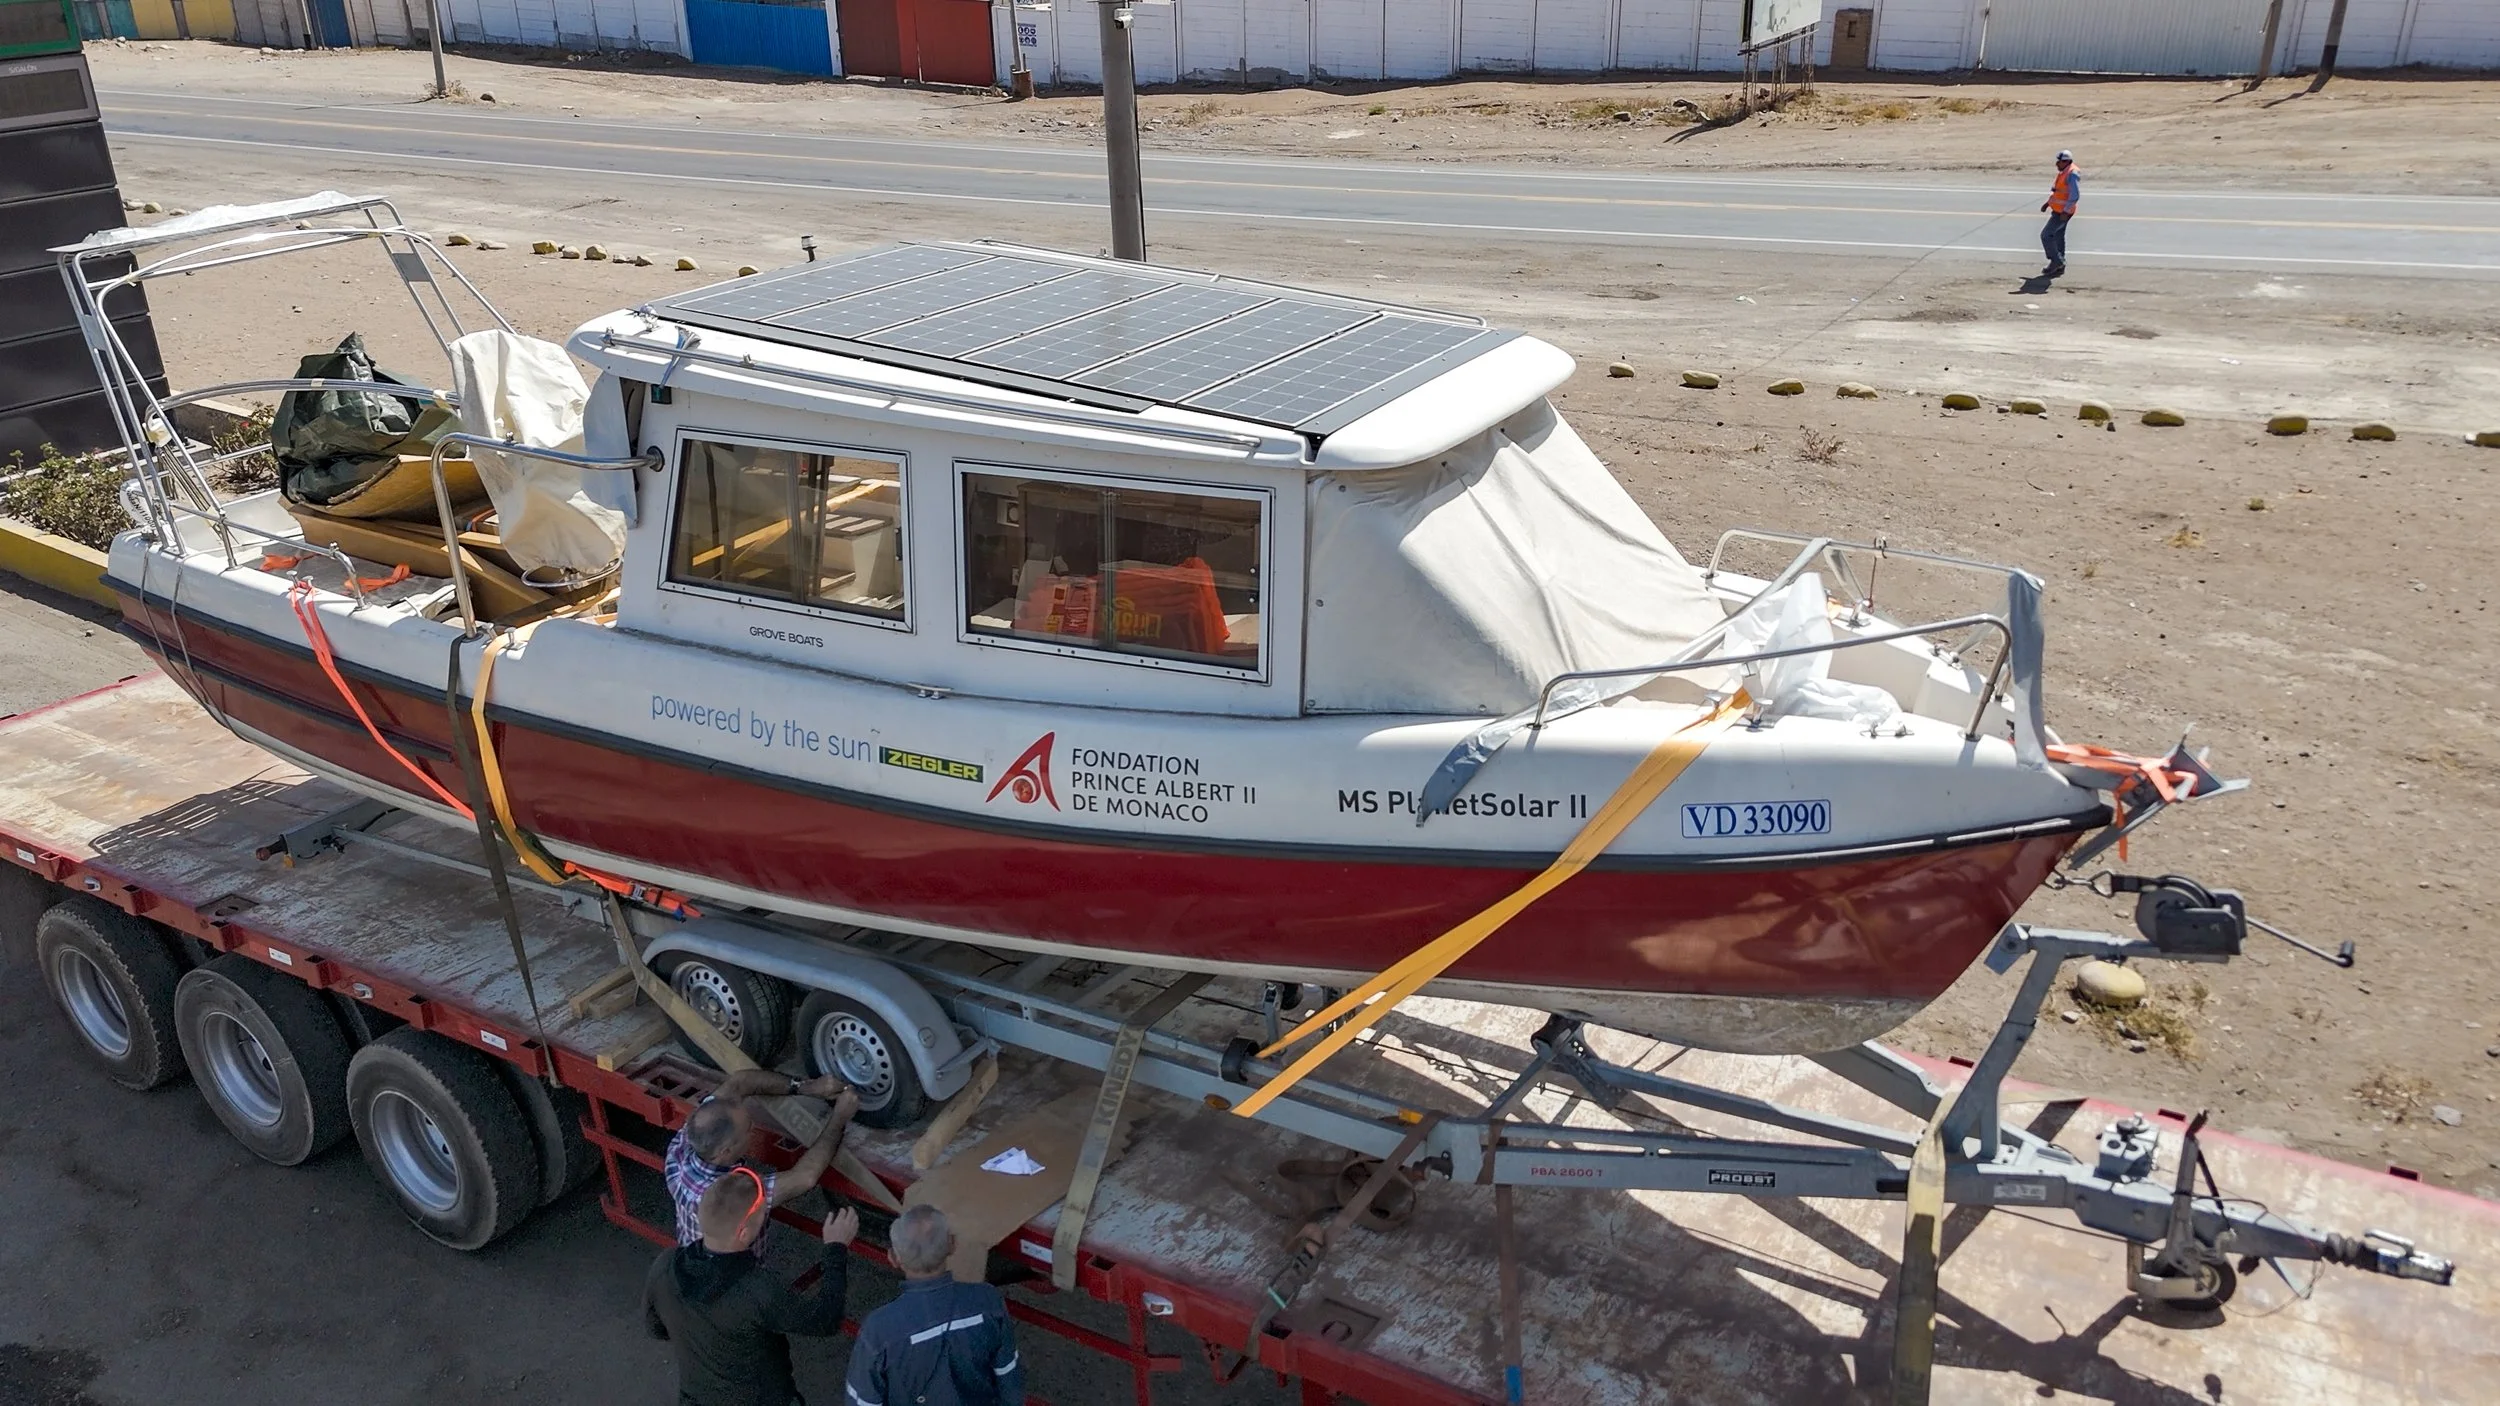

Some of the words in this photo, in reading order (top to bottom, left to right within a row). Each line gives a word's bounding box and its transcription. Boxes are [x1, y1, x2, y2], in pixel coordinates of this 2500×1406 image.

[749, 626, 786, 641] GROVE
[788, 633, 824, 648] BOATS
[652, 694, 741, 734] powered
[751, 711, 776, 747] by
[783, 719, 819, 752] the
[828, 735, 871, 763] sun
[888, 750, 978, 781] ZIEGLER
[1072, 748, 1199, 776] FONDATION
[1072, 771, 1147, 795] PRINCE
[1155, 779, 1235, 802] ALBERT
[1243, 786, 1256, 804] II
[1073, 794, 1099, 813] DE
[1106, 797, 1209, 823] MONACO
[1338, 789, 1379, 813] MS
[1388, 790, 1560, 818] PletSolar
[1570, 794, 1587, 818] II
[1686, 806, 1737, 835] VD
[1743, 803, 1826, 835] 33090
[1095, 1029, 1139, 1127] KINEDY
[1531, 1167, 1557, 1176] PBA
[1560, 1168, 1594, 1177] 2600
[1711, 1173, 1774, 1184] PROBST
